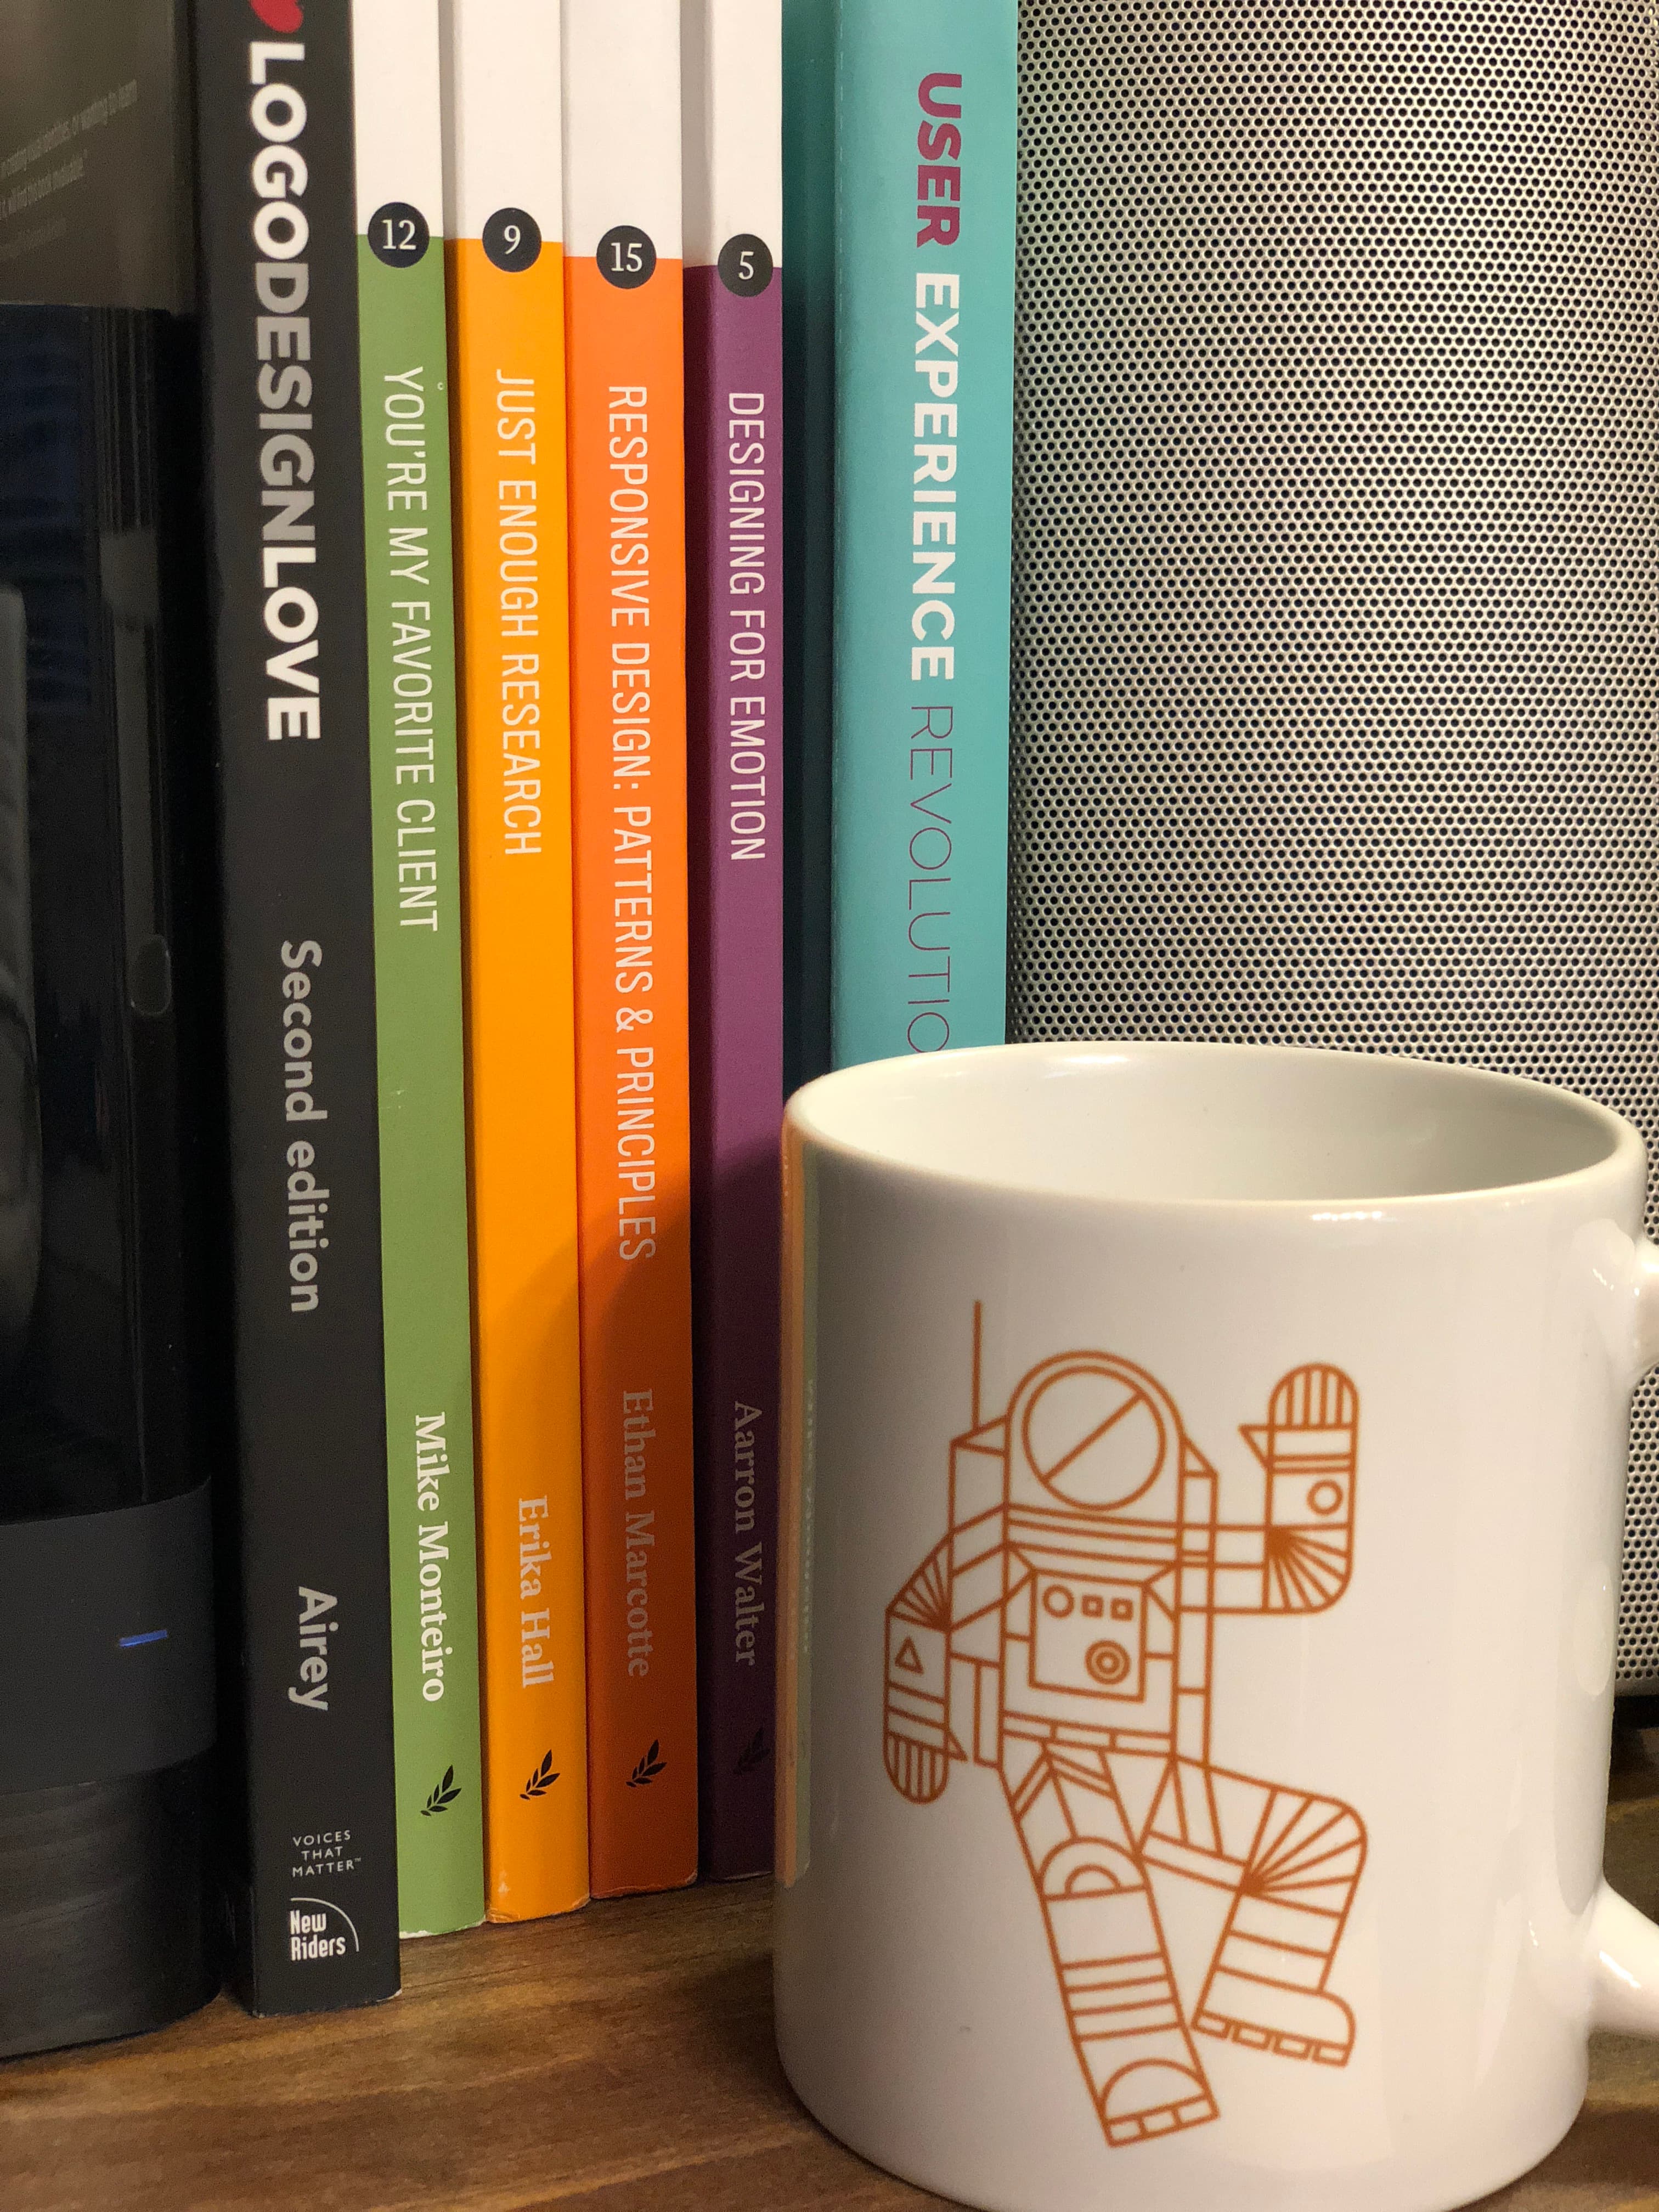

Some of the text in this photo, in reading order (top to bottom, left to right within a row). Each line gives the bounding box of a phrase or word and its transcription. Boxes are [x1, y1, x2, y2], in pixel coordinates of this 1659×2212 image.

[382, 221, 416, 251] 12
[504, 225, 521, 254] 9
[917, 72, 962, 248] USER
[610, 242, 643, 272] 15
[738, 251, 754, 280] 5
[911, 273, 960, 680] EXPERIENCE
[383, 366, 438, 932] YOU'RE MY FAVORITE CLIENT
[495, 369, 542, 855] JUST ENOUGH RESEARCH
[729, 392, 766, 860] DESIGNING FOR EMOTION
[608, 386, 656, 1260] RESPONSIVE DESIGN: PATTERNS & PRINCIPLES
[281, 940, 329, 1312] Second edition
[415, 1412, 453, 1701] Mike Monteiro
[518, 1496, 554, 1688] Erika Hall
[622, 1389, 656, 1677] Ethan Marcotte
[733, 1401, 764, 1666] Aarron Walter
[289, 1586, 337, 1711] Airey
[290, 1910, 326, 1935] New
[292, 1830, 351, 1847] VOICES
[301, 1846, 343, 1861] THAT
[291, 1934, 346, 1961] Riders
